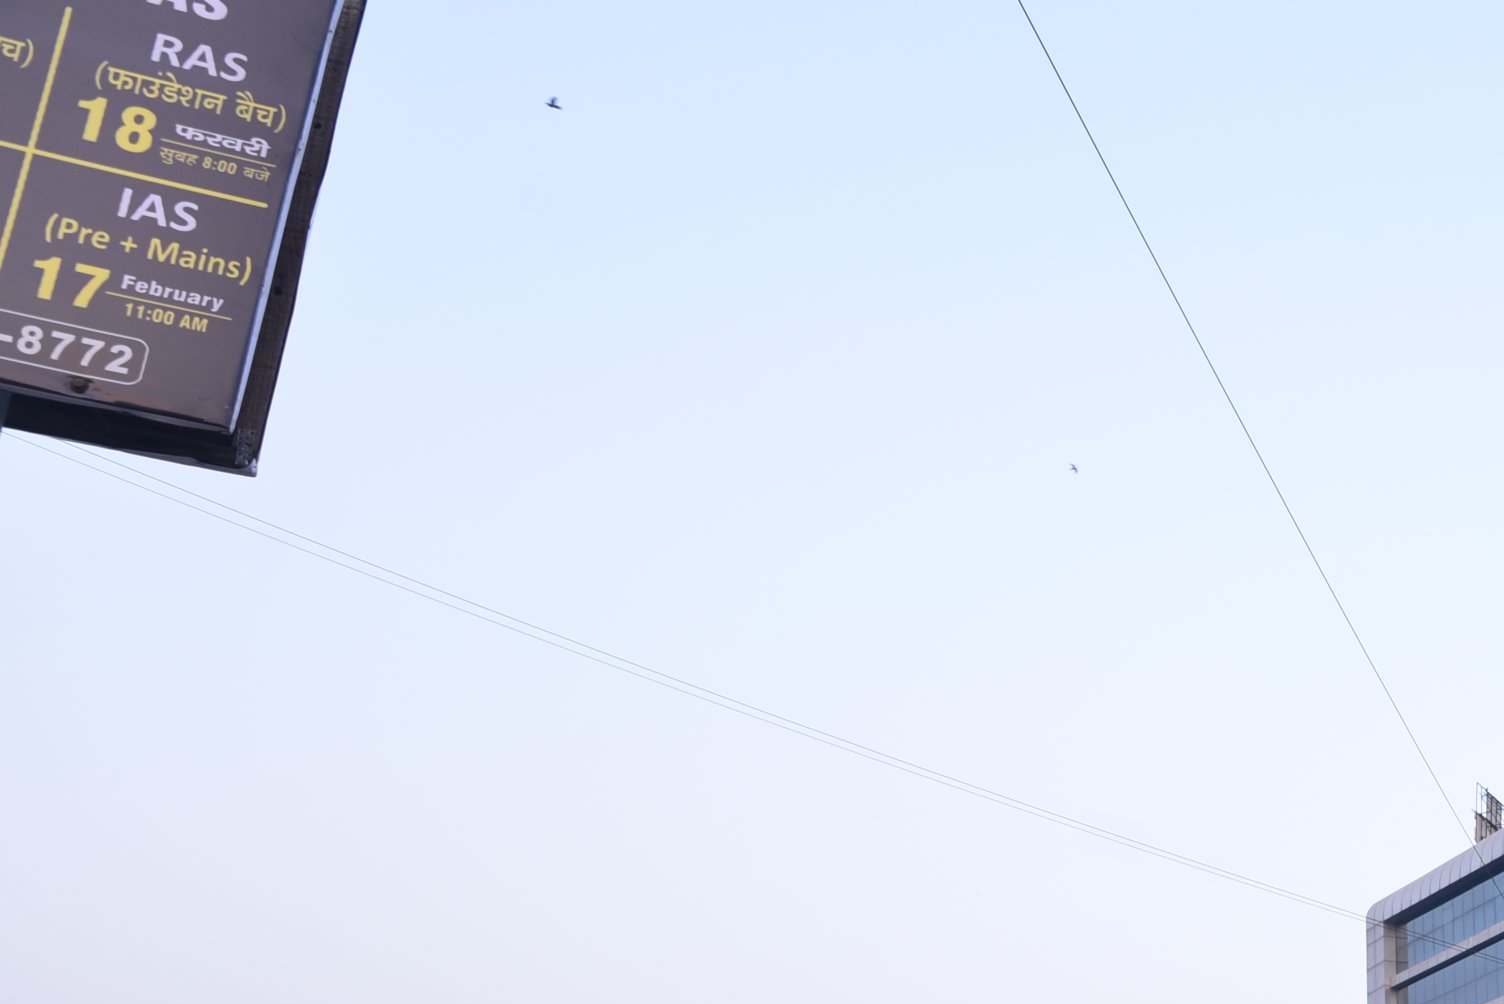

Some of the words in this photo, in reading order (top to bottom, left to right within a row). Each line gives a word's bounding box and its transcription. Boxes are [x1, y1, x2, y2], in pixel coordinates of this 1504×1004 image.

[150, 33, 249, 83] RAS
[95, 61, 227, 115] (फाउंडेशन
[236, 91, 287, 132] बैच)
[77, 97, 158, 153] 18
[175, 122, 271, 158] फरवरी
[202, 156, 237, 175] 8:00
[117, 187, 199, 232] IAS
[45, 213, 110, 252] (Pre
[120, 235, 138, 253] +
[147, 237, 252, 286] Mains)
[33, 256, 111, 309] 17
[121, 274, 224, 312] February
[125, 302, 175, 327] 11:00
[179, 313, 208, 333] AM
